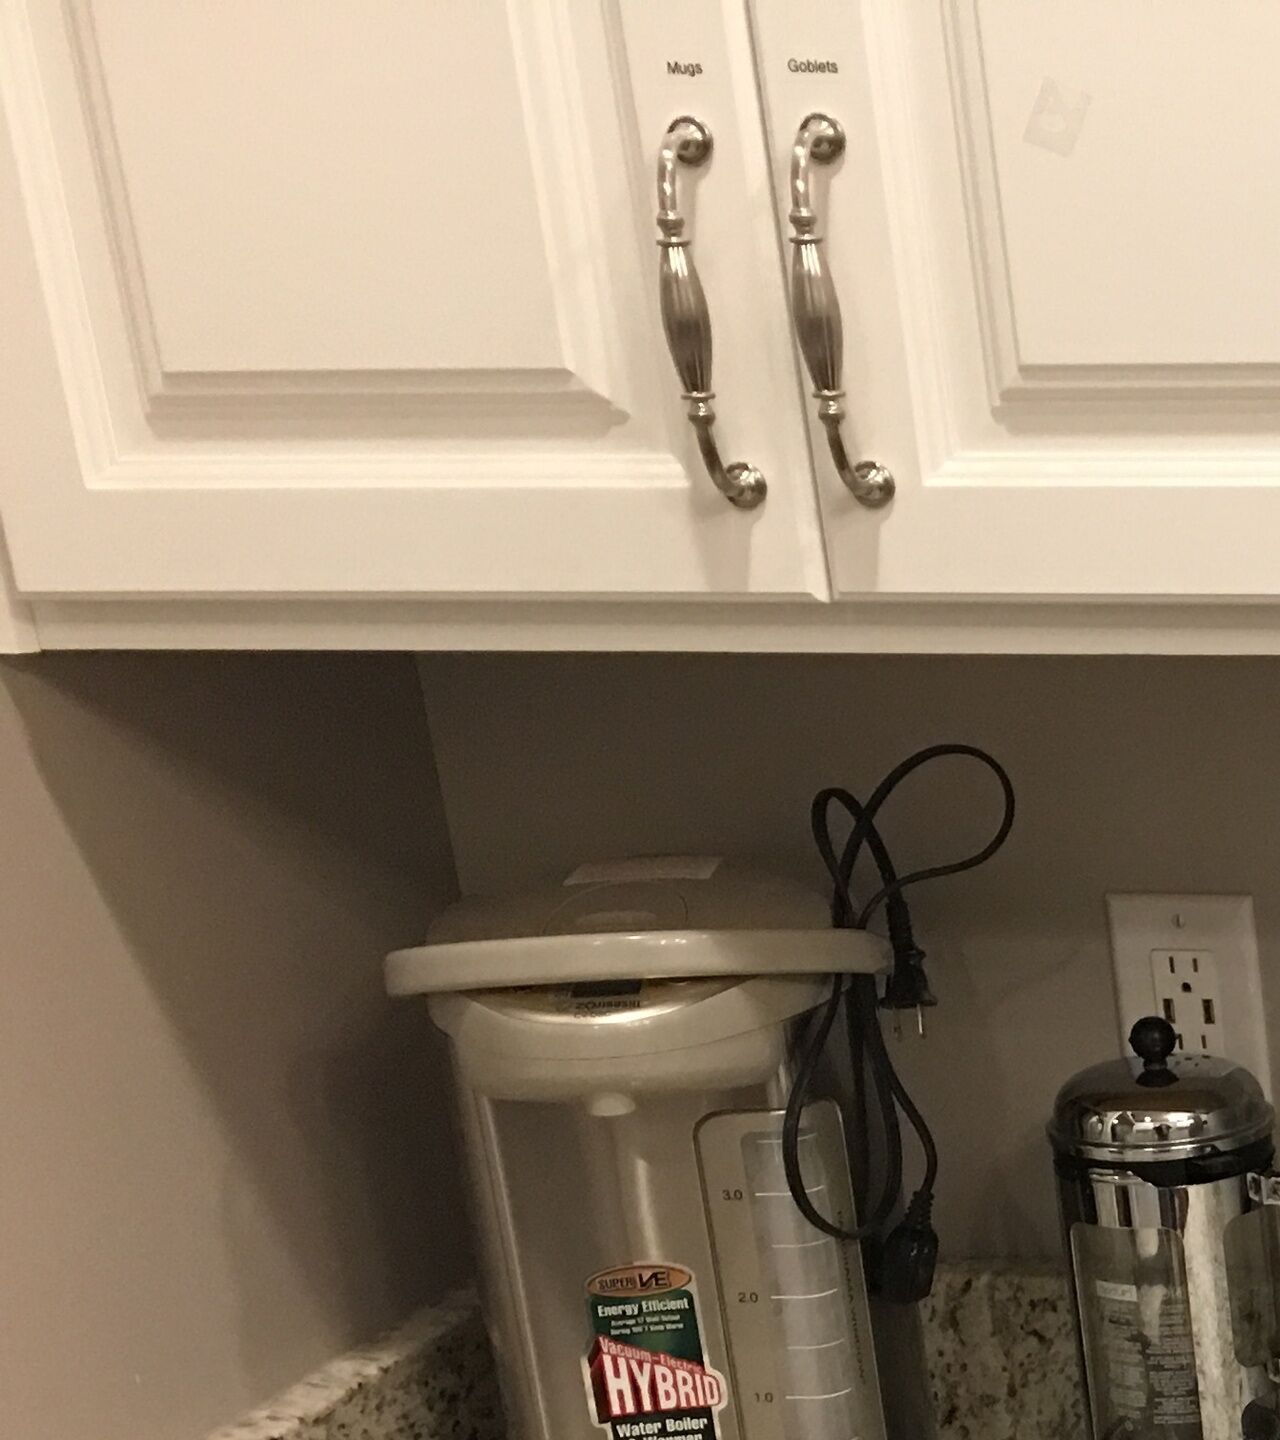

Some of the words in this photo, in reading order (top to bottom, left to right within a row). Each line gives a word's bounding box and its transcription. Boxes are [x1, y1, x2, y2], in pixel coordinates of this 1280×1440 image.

[667, 61, 703, 77] Mugs
[787, 58, 838, 74] Goblets
[722, 1189, 743, 1201] 3.0
[597, 1304, 639, 1317] Energy
[642, 1298, 690, 1313] Efficient
[602, 1354, 720, 1415] HYBRID
[616, 1422, 662, 1438] Water
[665, 1417, 708, 1432] Boiler
